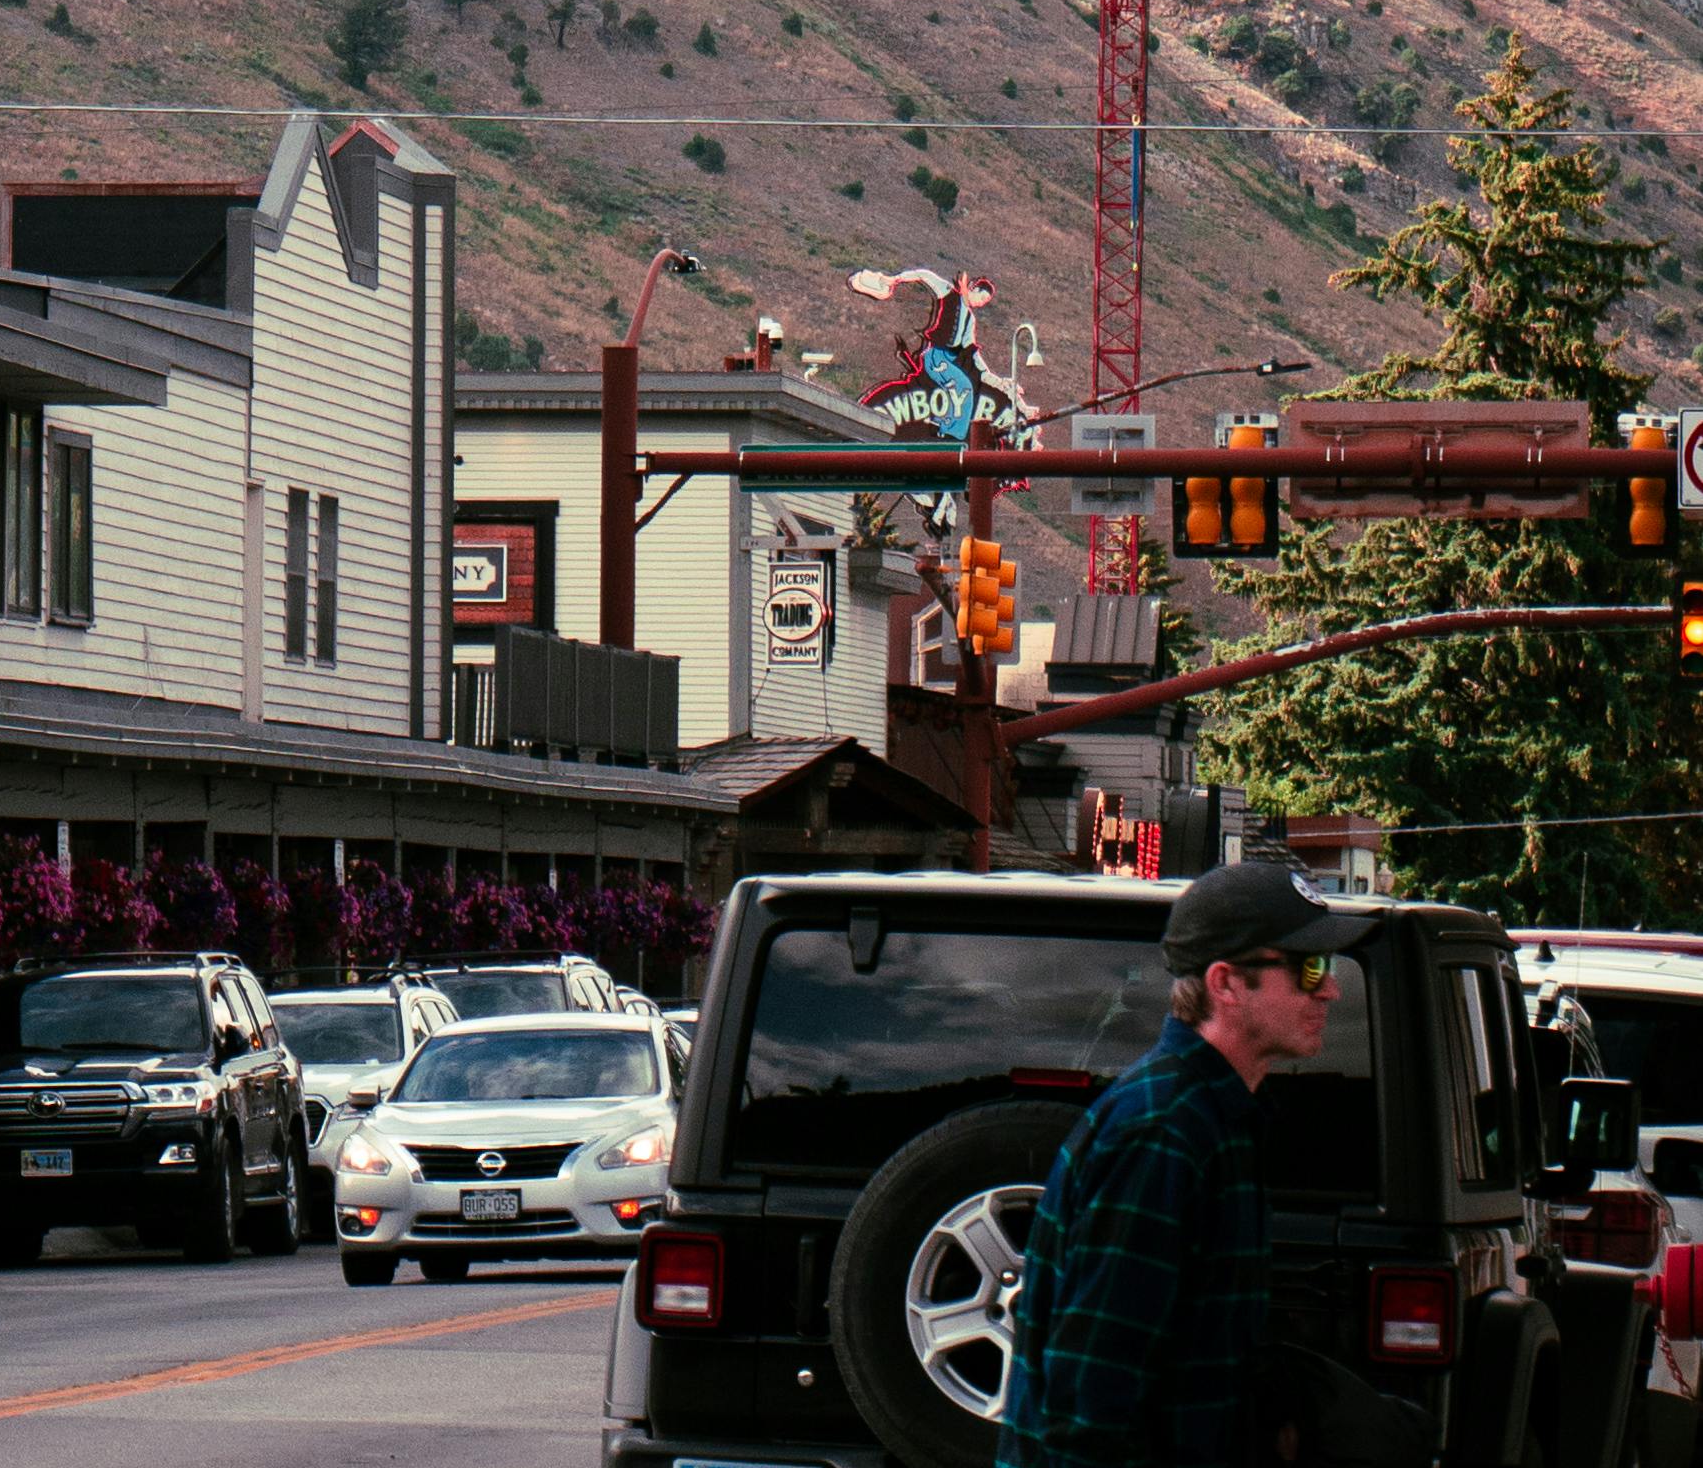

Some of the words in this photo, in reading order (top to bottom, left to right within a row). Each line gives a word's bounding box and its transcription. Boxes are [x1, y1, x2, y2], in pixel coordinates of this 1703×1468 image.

[874, 386, 973, 426] WBOY
[774, 574, 819, 586] JACKSON
[770, 603, 813, 627] TRADING
[771, 646, 818, 658] COMPANY
